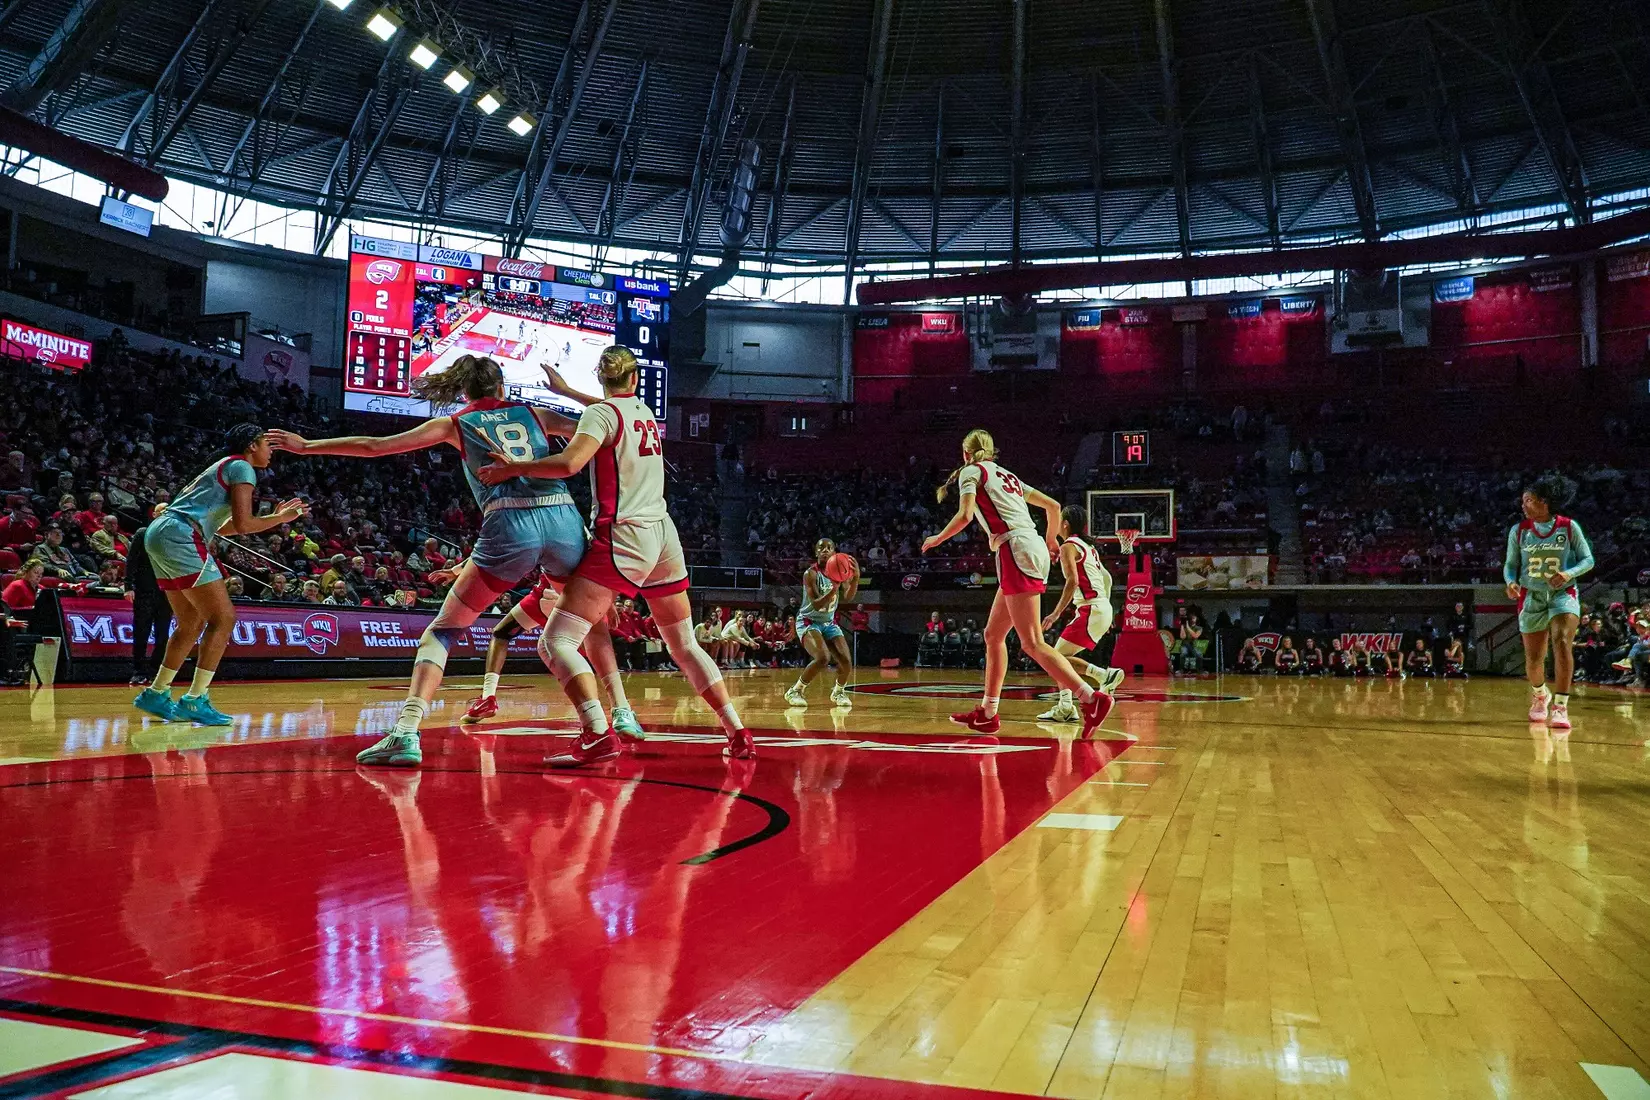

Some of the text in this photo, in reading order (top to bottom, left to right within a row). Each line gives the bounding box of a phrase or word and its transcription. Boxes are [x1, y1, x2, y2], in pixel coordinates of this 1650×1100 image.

[431, 248, 463, 261] LOGAN
[429, 257, 460, 266] ALUMINUM
[563, 269, 591, 280] CHEETAH
[574, 276, 591, 285] Clean
[509, 279, 531, 293] 9:07
[375, 290, 389, 310] 2
[1282, 300, 1315, 309] LIBERTY
[353, 323, 372, 331] PLAYER
[6, 323, 89, 360] McMINUTE
[359, 335, 405, 348] 1 0 0
[638, 326, 650, 344] 0
[357, 346, 404, 359] 3 0 0
[378, 358, 385, 367] 0
[397, 360, 404, 369] 0
[354, 366, 404, 379] 23 0 0
[353, 377, 403, 390] 33 0 0
[480, 412, 509, 423] AIREY
[634, 420, 662, 457] 23
[1127, 445, 1142, 461] 19
[995, 471, 1024, 498] 33
[1528, 557, 1560, 578] 23
[67, 614, 332, 647] McUTE WKU
[359, 620, 403, 634] FREE
[363, 635, 422, 648] Medium
[1258, 636, 1274, 645] WKU
[1340, 633, 1404, 653] WKU
